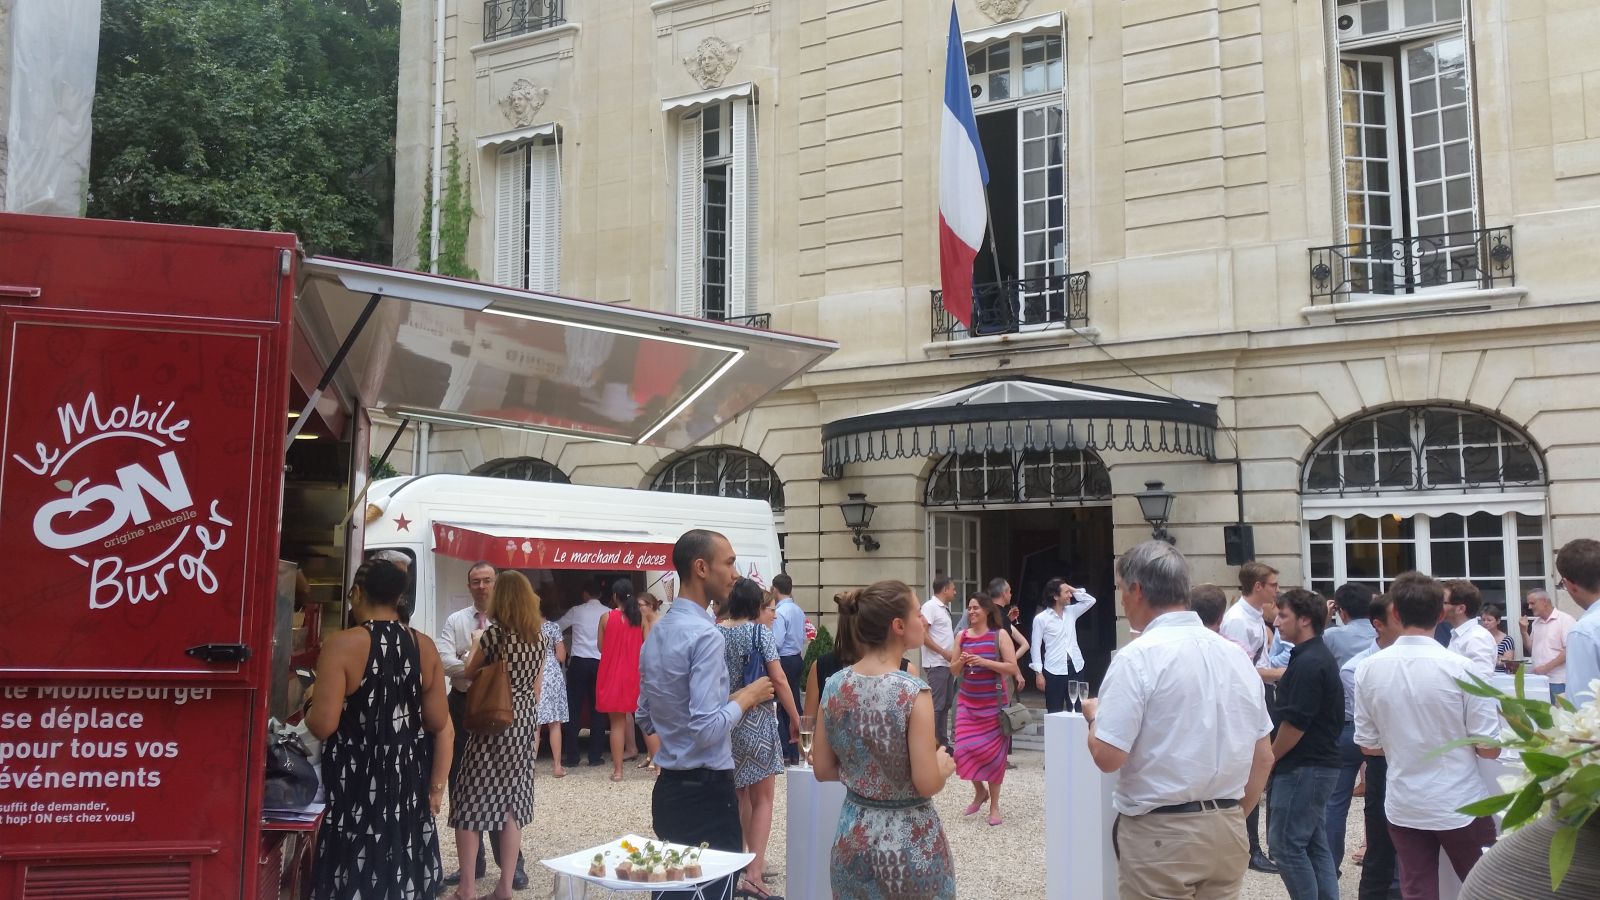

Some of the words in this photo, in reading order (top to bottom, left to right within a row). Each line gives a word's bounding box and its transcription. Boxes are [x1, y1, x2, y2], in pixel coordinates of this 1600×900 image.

[57, 391, 190, 444] Mobile
[104, 528, 145, 548] origine
[147, 508, 198, 533] naturelle
[88, 499, 233, 610] Burger
[553, 547, 567, 563] Le
[570, 549, 622, 564] marchand
[623, 550, 635, 564] de
[636, 550, 667, 569] glaces
[1, 711, 32, 729] se
[40, 706, 144, 733] déplace
[0, 741, 63, 764] pour
[70, 738, 128, 758] tous
[135, 741, 179, 758] vos
[0, 766, 161, 789] événements
[6, 814, 32, 826] hop!
[35, 813, 52, 824] ON
[55, 814, 73, 823] est
[76, 812, 102, 823] chez
[104, 811, 135, 823] vous)
[30, 802, 45, 812] de
[47, 801, 110, 813] demander,
